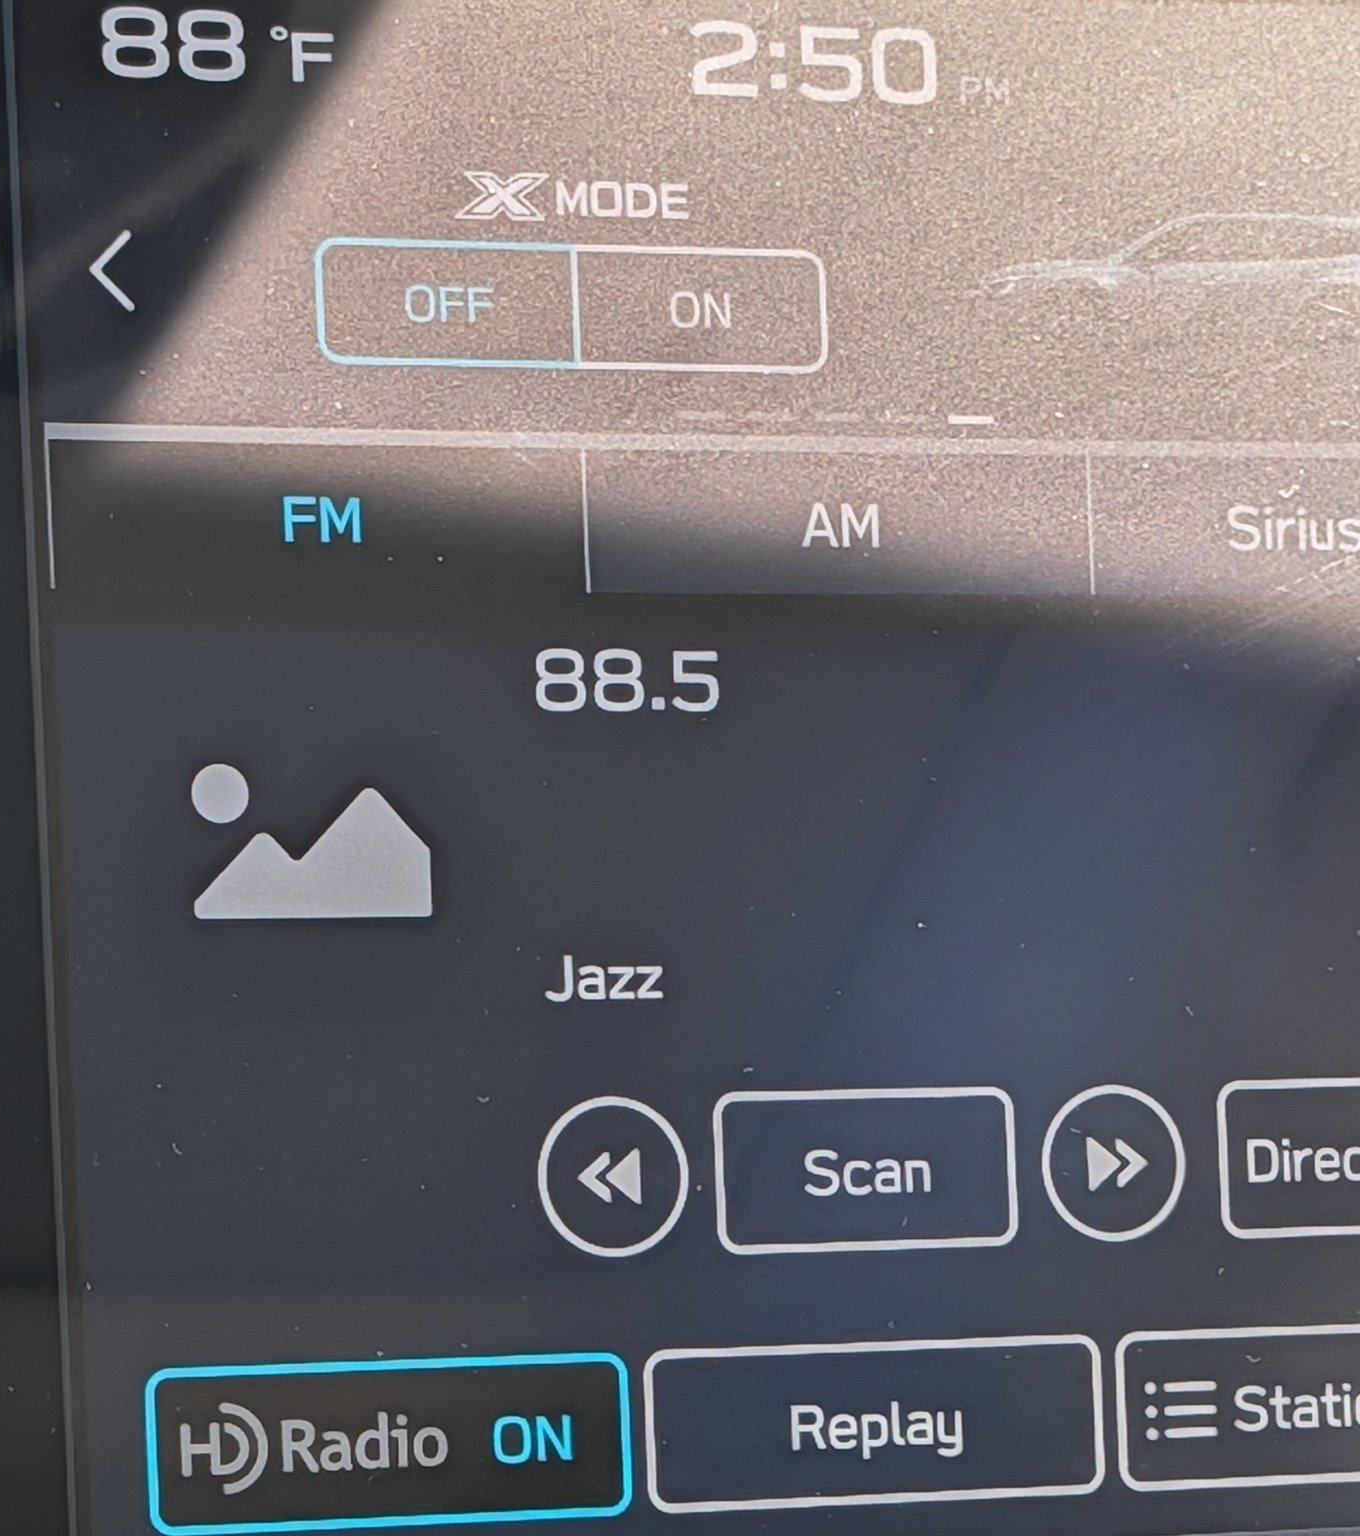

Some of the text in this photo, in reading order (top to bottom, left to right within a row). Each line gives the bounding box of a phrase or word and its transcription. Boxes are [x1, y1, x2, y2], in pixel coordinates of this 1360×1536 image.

[100, 6, 247, 82] 88
[690, 20, 1011, 107] 2:50 PM
[554, 182, 690, 220] MODE
[404, 285, 493, 324] OFF
[669, 292, 732, 330] ON
[283, 495, 362, 544] FM
[802, 502, 880, 549] AM
[534, 647, 721, 714] 88.5
[545, 955, 664, 1004] Jazz
[802, 1148, 933, 1196] Scan
[279, 1411, 449, 1474] Radio
[491, 1413, 573, 1465] ON
[789, 1400, 965, 1460] Replay
